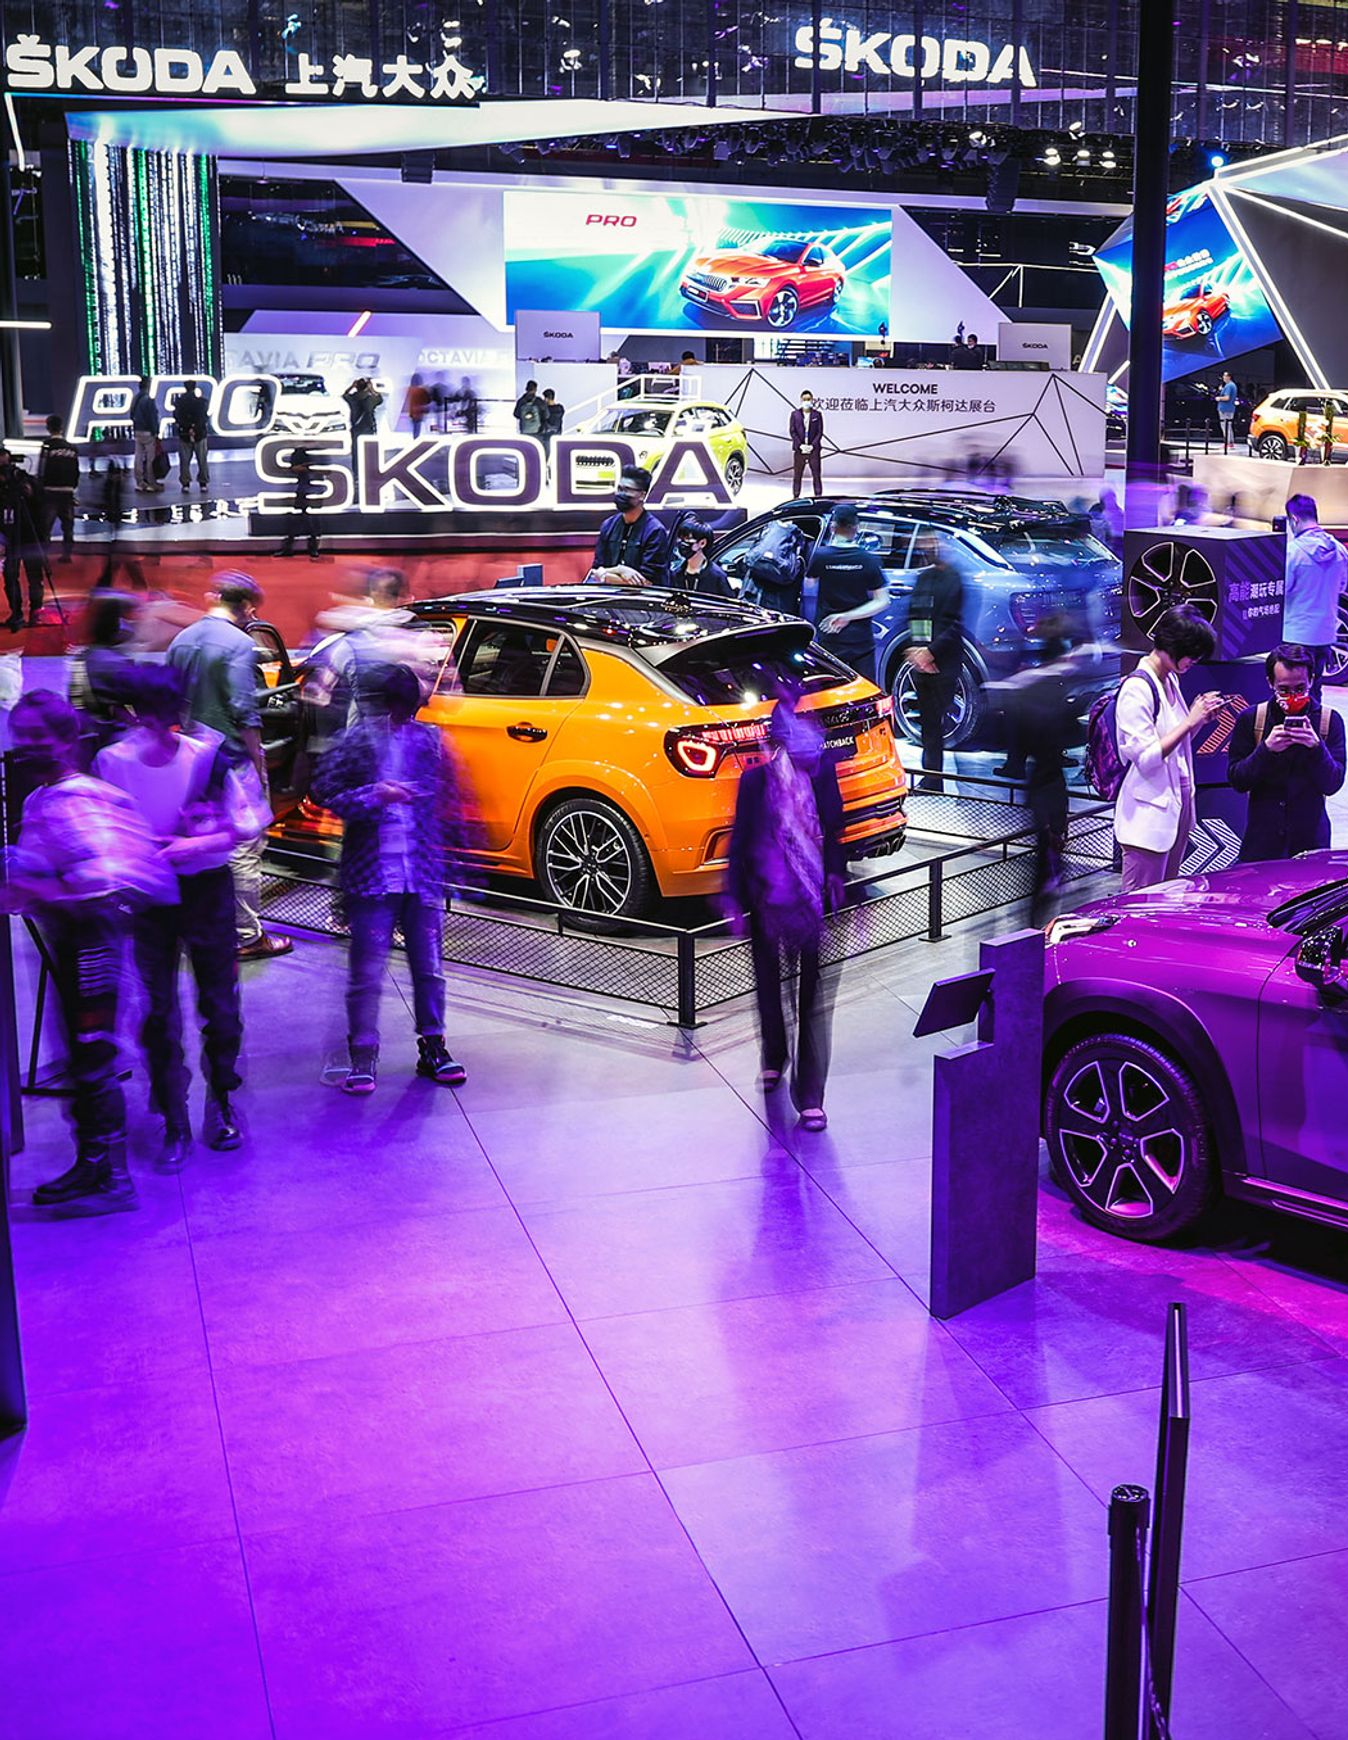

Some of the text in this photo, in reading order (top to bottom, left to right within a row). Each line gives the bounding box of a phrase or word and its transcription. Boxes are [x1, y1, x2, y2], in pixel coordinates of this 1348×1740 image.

[6, 34, 256, 95] ŠKODA
[285, 52, 477, 100] 上汽大众
[585, 214, 637, 227] PRO
[66, 374, 282, 444] PRO
[872, 383, 938, 395] WELCOME
